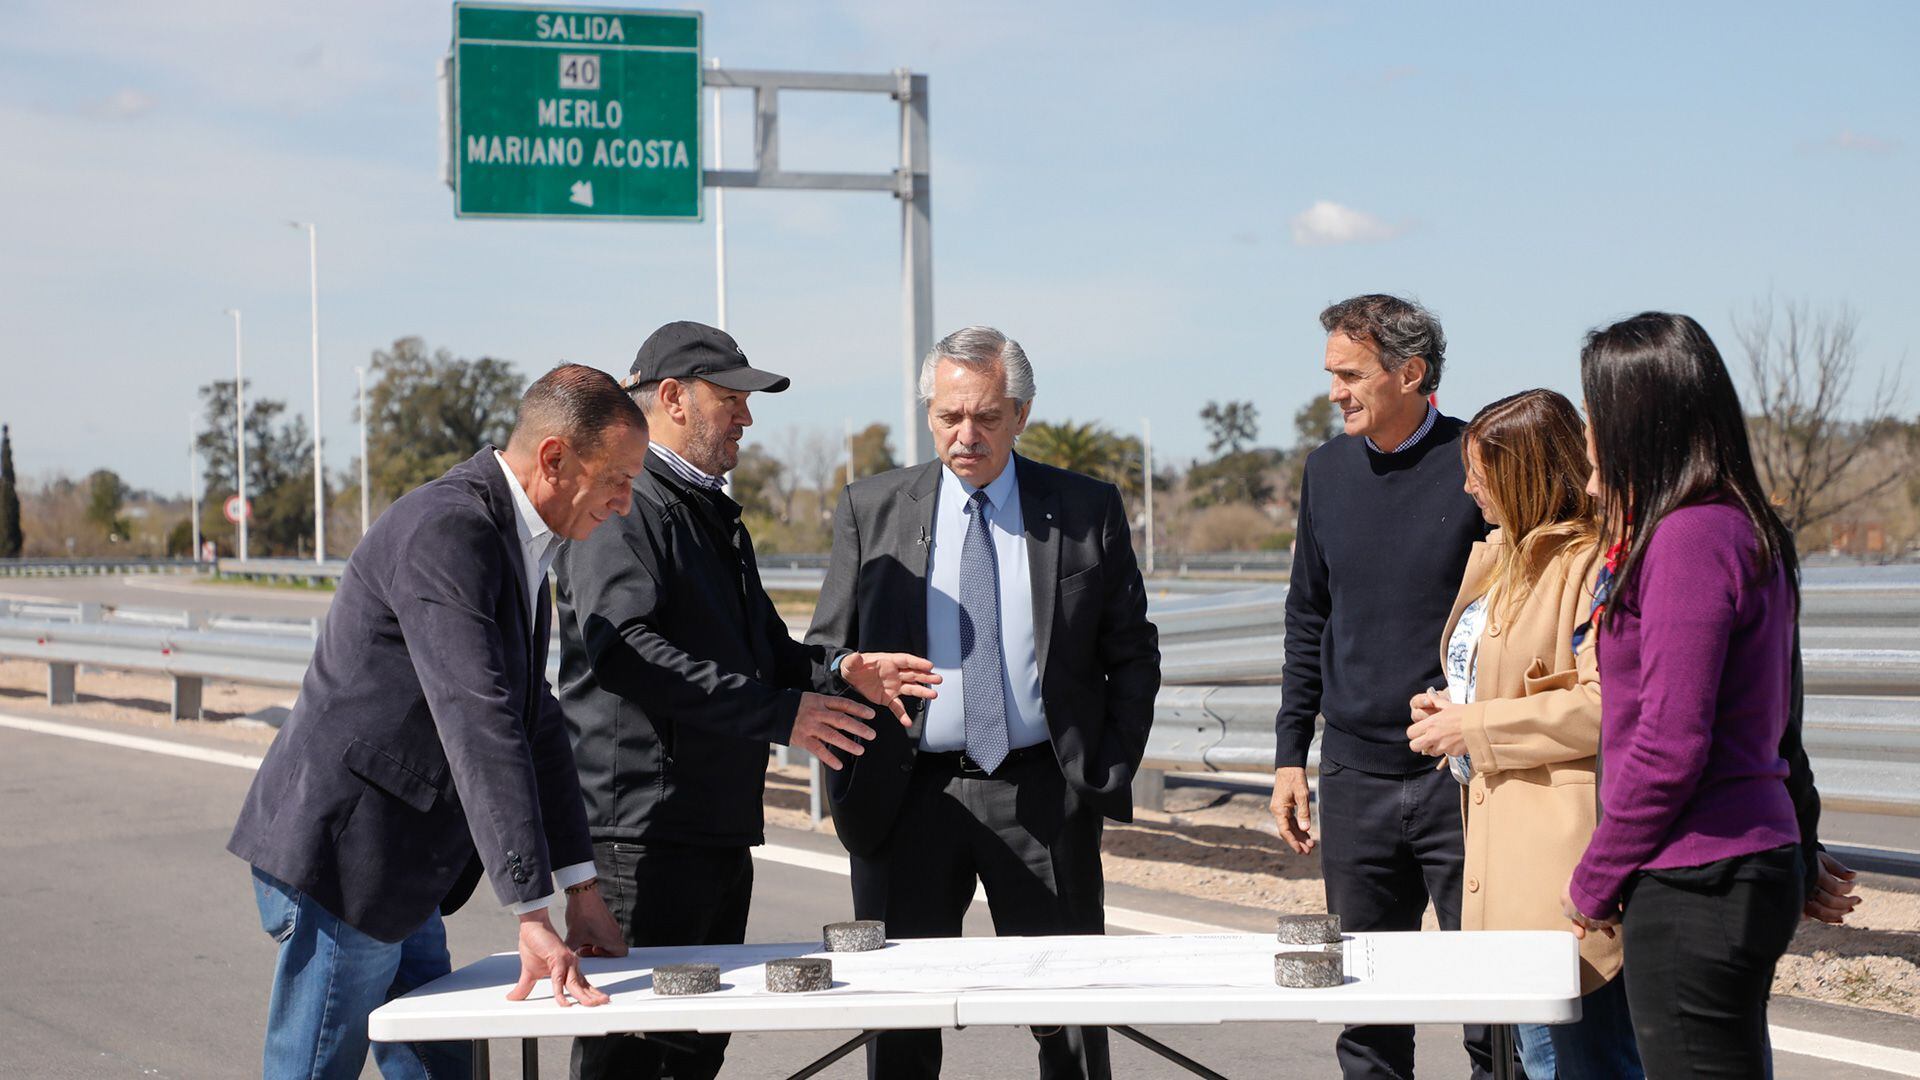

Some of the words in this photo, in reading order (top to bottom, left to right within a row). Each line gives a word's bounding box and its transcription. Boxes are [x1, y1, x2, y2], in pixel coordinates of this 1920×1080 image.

[536, 14, 625, 41] SALIDA
[564, 59, 596, 85] 40
[538, 98, 623, 129] MERLO
[467, 135, 583, 166] MARIANO
[593, 138, 689, 168] ACOSTA
